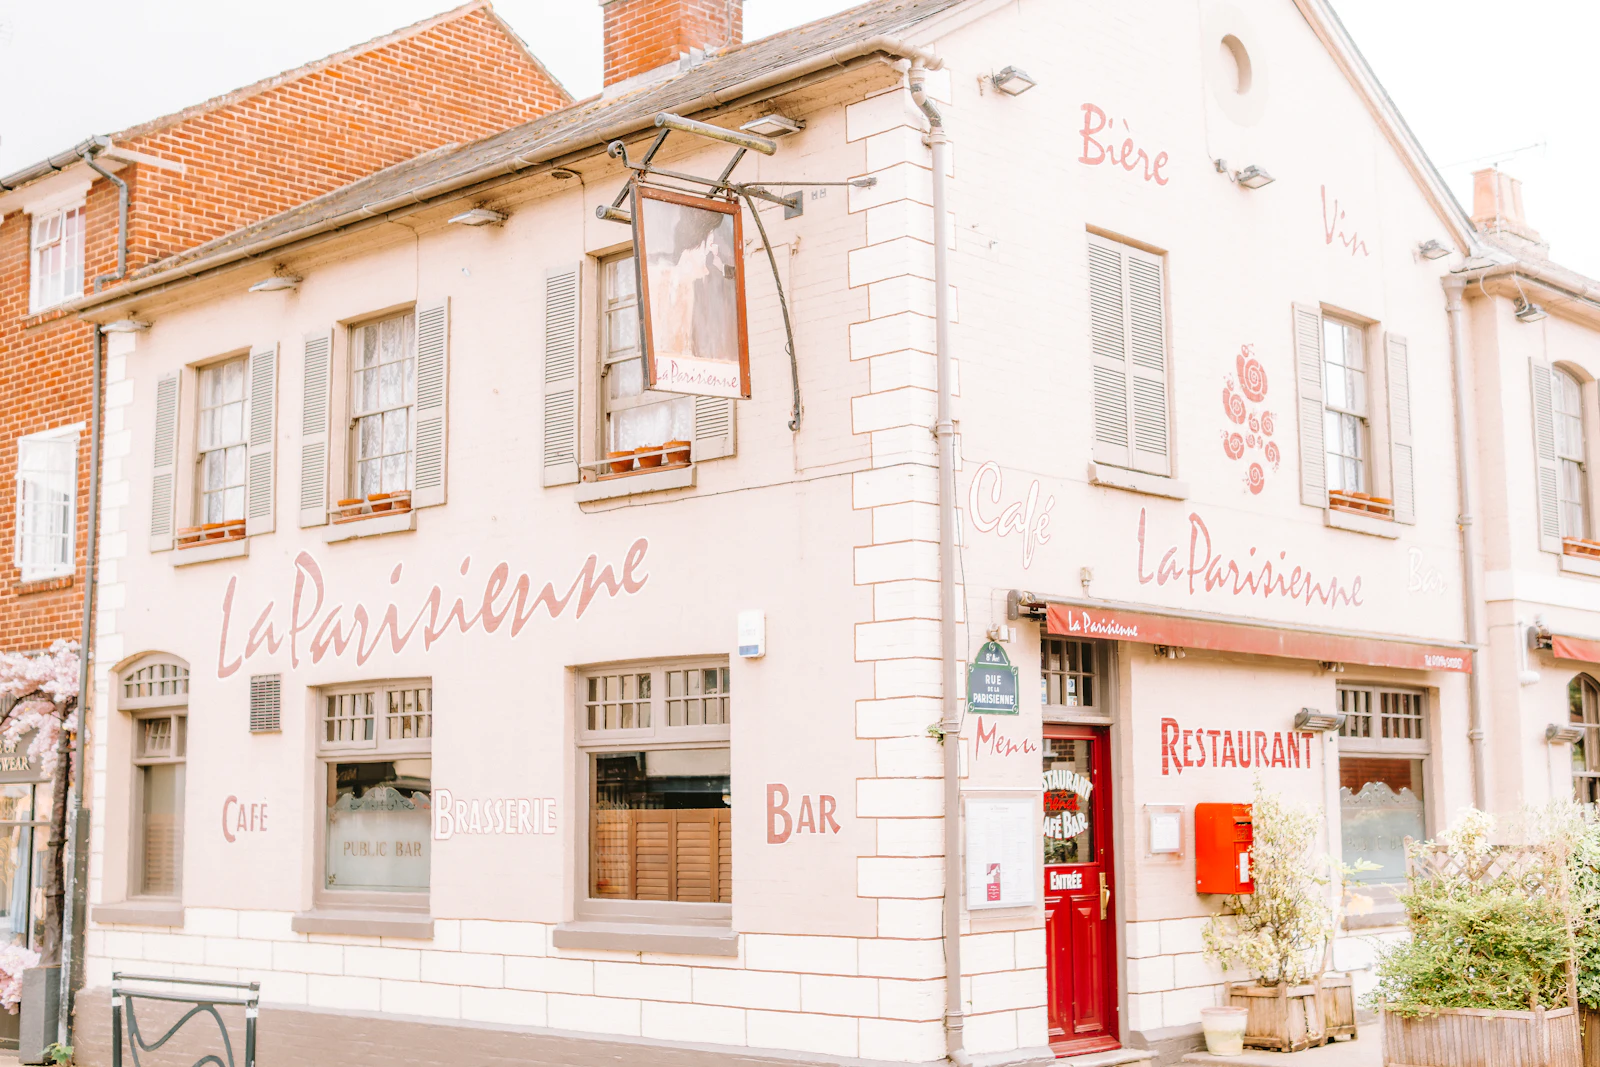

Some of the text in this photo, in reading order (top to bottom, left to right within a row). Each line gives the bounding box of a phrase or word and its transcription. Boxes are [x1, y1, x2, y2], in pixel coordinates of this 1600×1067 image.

[1078, 102, 1169, 186] Bière
[1320, 184, 1370, 257] Vin
[968, 460, 1056, 570] Café
[1187, 511, 1364, 610] Parisienne
[288, 537, 649, 670] Parisienne
[1068, 610, 1138, 637] La Parisienne
[973, 692, 1014, 704] PARISIENNE
[985, 674, 1001, 685] RUE
[975, 715, 1038, 761] Menu
[343, 841, 422, 856] PUBLIC BAR
[1043, 814, 1063, 840] AFÉ
